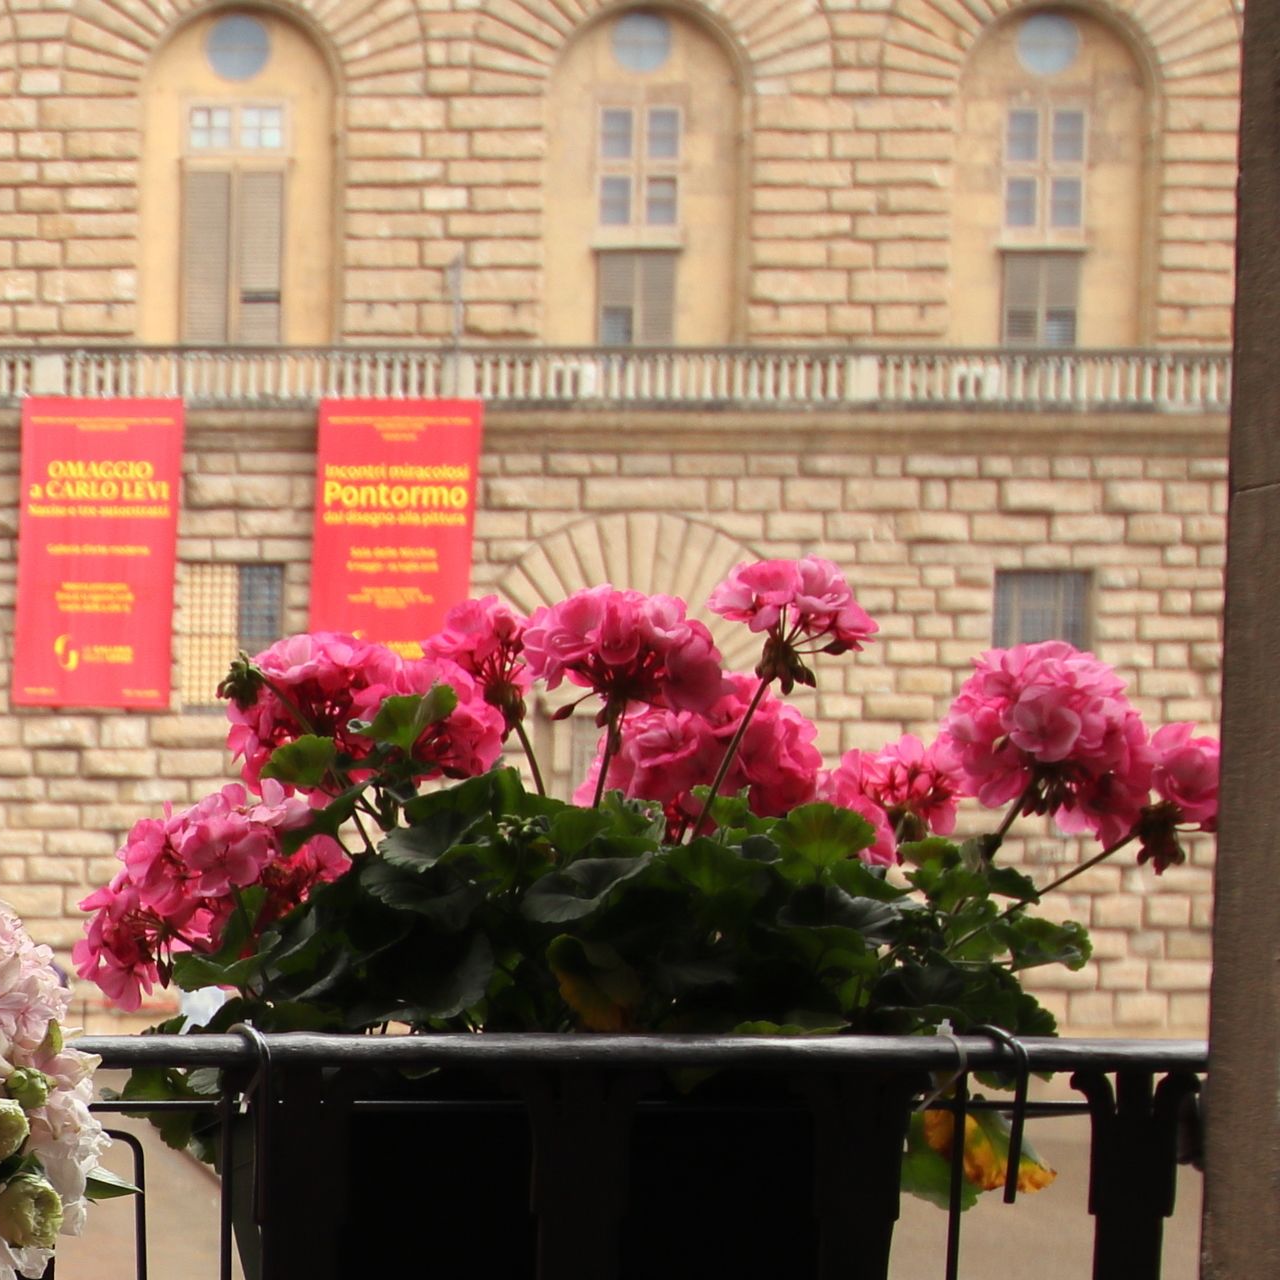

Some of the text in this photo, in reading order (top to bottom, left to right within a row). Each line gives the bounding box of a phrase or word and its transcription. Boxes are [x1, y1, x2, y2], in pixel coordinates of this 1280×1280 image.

[47, 460, 154, 479] OMAGGIO
[325, 463, 469, 480] Incontri miracolosi
[29, 480, 169, 499] a CARLO LEVI
[324, 480, 468, 509] Pontormo
